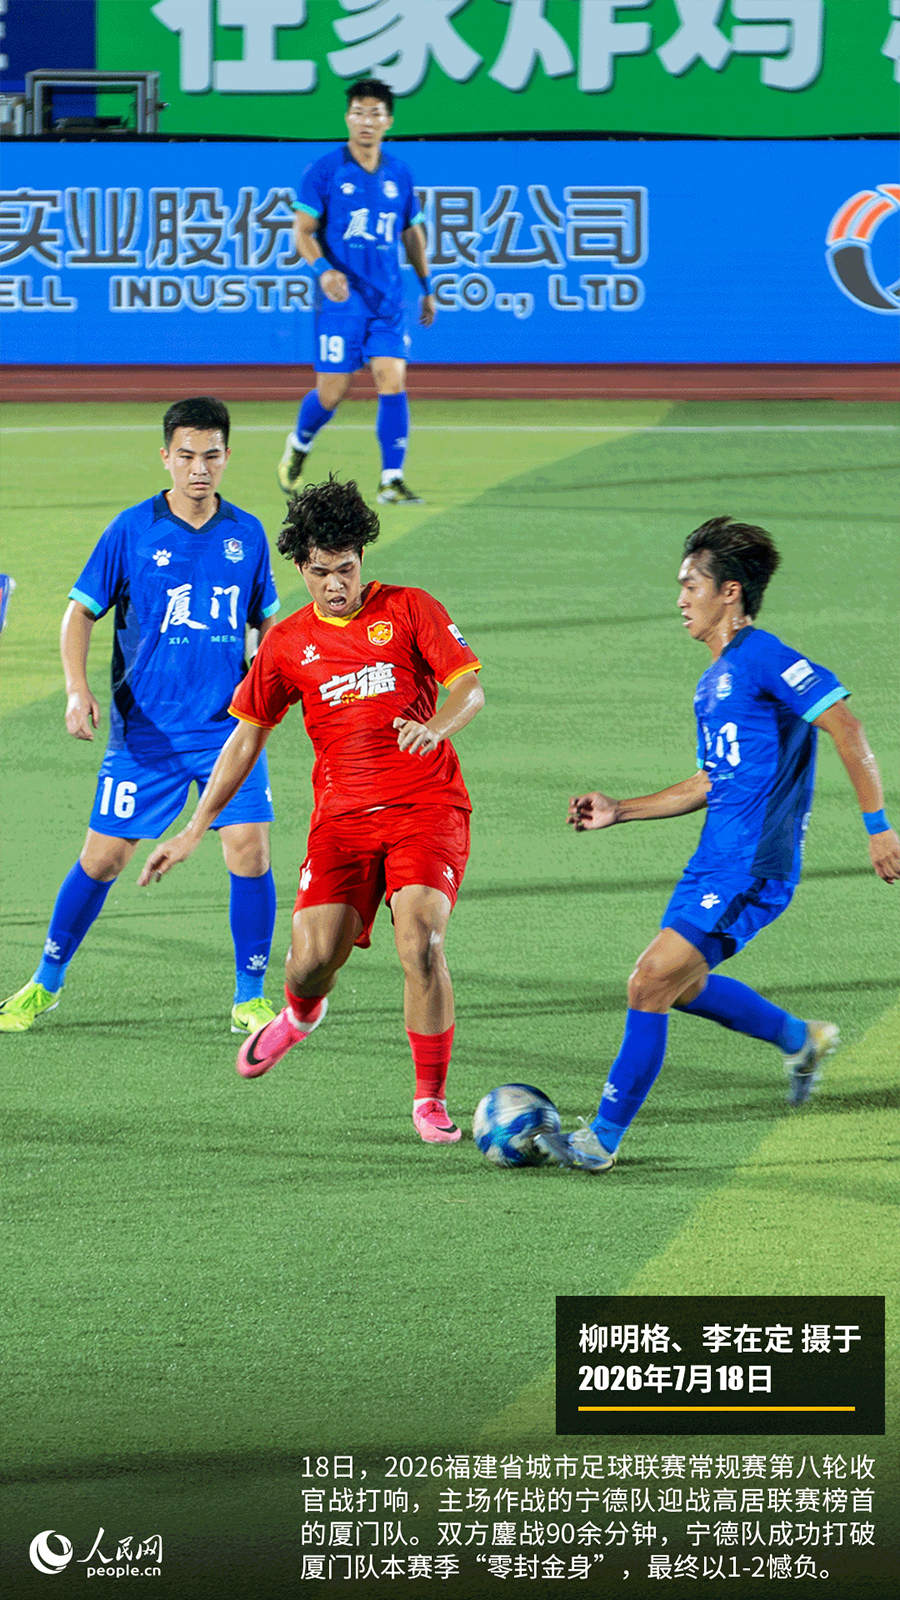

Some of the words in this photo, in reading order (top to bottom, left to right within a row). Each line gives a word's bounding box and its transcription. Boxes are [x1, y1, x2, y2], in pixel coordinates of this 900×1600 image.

[109, 275, 313, 312] INDUSTR
[548, 274, 645, 311] LTD
[319, 334, 345, 363] 19
[160, 583, 240, 634] 厦门
[168, 636, 190, 645] XIA
[318, 661, 397, 707] 宁德
[99, 776, 138, 819] 16
